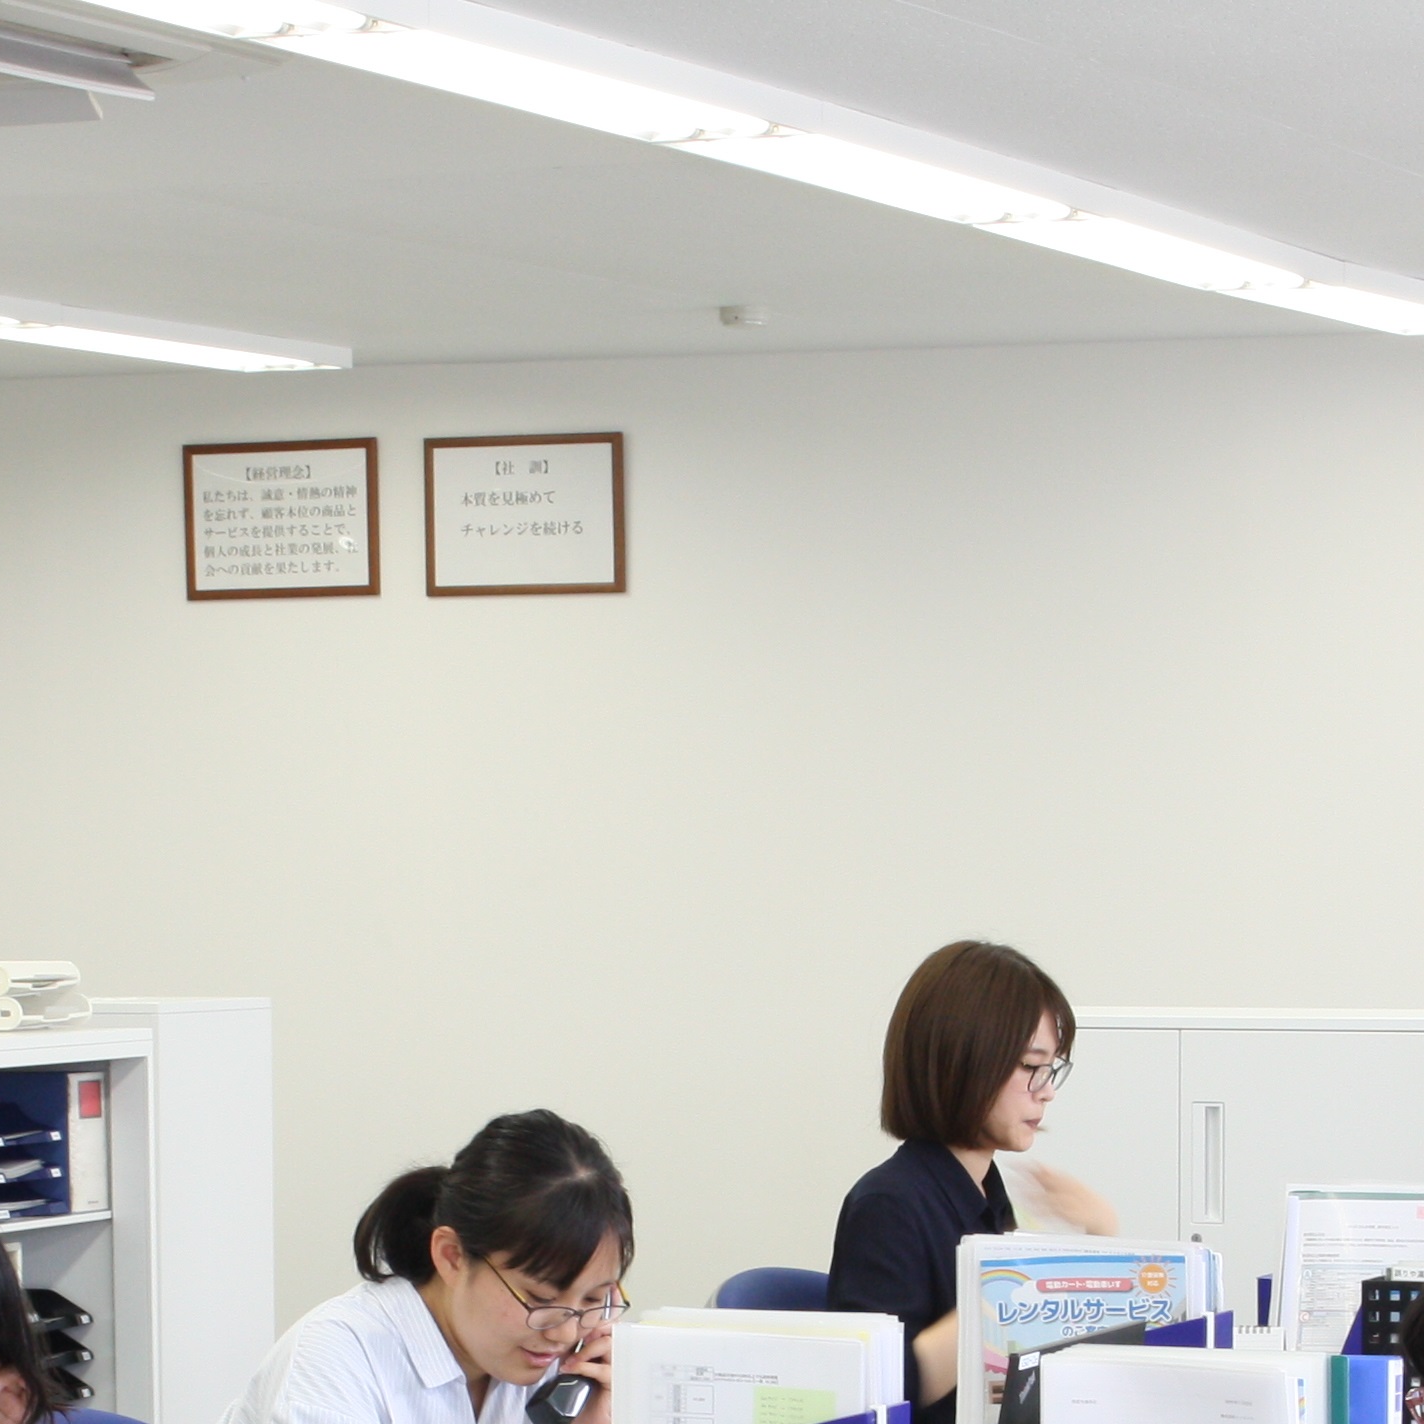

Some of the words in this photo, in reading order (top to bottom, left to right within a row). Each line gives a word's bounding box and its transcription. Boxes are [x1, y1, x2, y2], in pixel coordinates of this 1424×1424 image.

[246, 465, 311, 481] 【経営理念】
[462, 490, 556, 507] 本質を見極めて
[204, 524, 351, 539] サービスを提供することで、
[461, 520, 584, 538] チャレンジを続ける
[997, 1298, 1173, 1324] レンタルサービス
